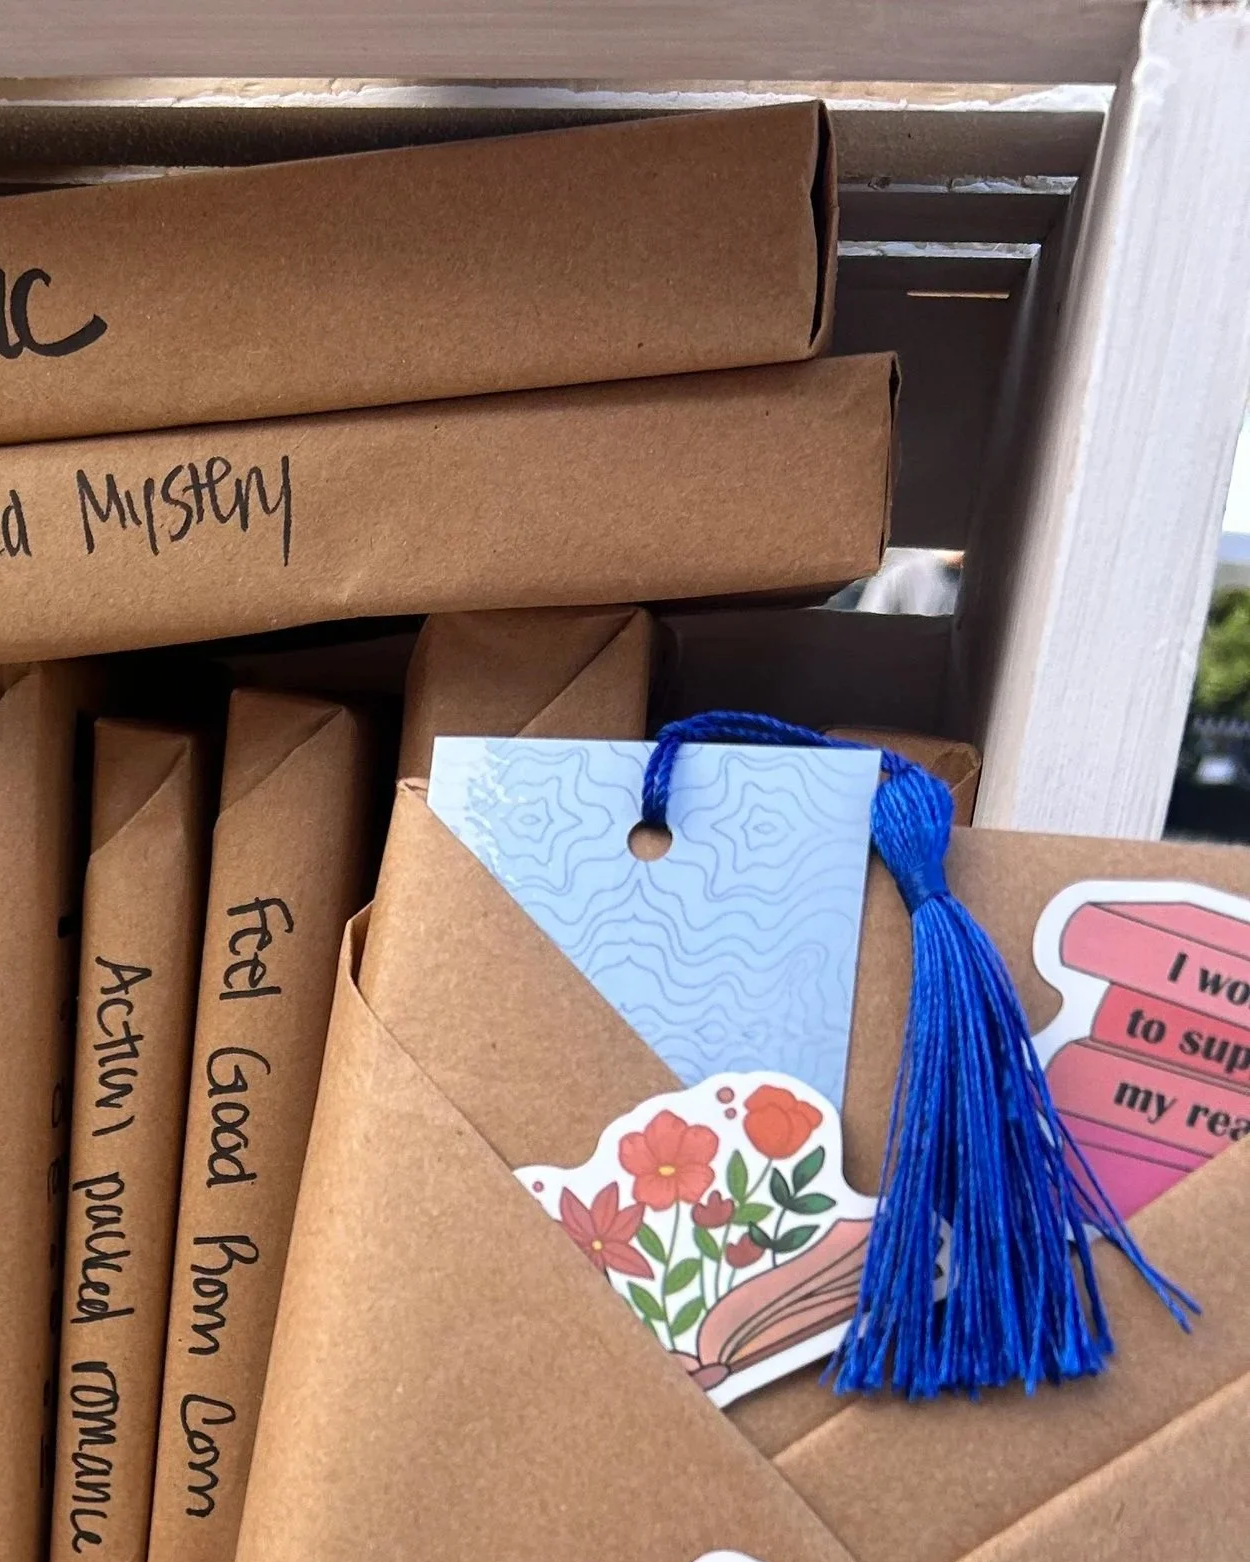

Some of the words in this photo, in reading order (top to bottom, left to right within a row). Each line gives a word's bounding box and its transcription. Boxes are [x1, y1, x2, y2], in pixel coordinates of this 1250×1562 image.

[76, 454, 294, 566] Mystery
[226, 896, 294, 1000] Feel
[1168, 952, 1188, 982] I
[1198, 965, 1250, 1006] wo
[92, 954, 152, 1138] Action
[1126, 1009, 1166, 1044] to
[204, 1044, 271, 1188] Good
[1113, 1082, 1176, 1124] my
[72, 1171, 134, 1325] packed
[189, 1233, 260, 1356] Rom
[68, 1360, 117, 1554] romance
[178, 1393, 236, 1518] Com
